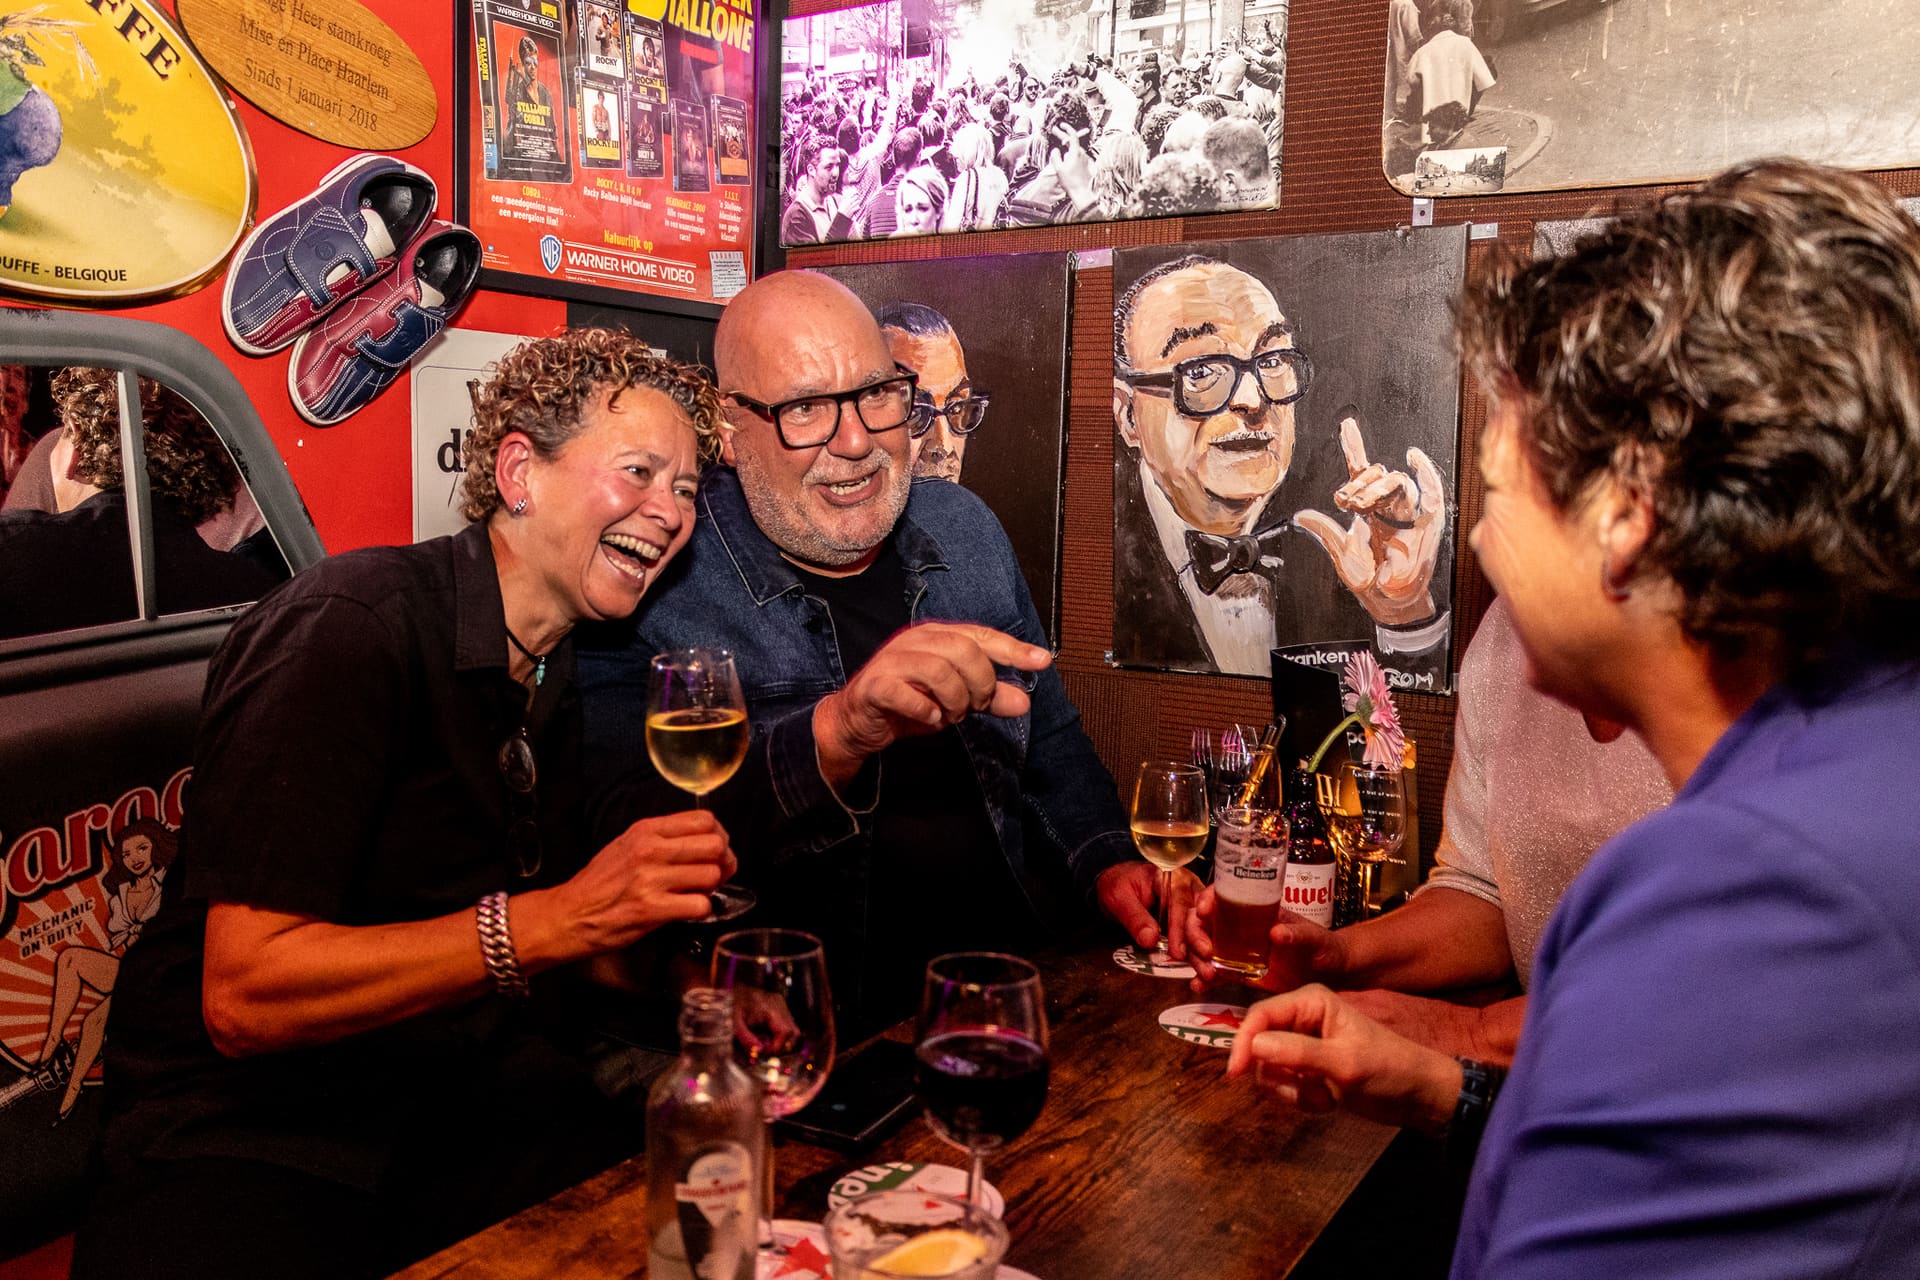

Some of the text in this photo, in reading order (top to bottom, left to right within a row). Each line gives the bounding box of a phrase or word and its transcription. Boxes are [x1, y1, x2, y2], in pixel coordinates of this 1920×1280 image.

[496, 5, 521, 19] WARNER
[519, 13, 538, 24] HOME
[538, 18, 554, 28] VIDEO
[291, 0, 324, 31] Heer
[326, 22, 393, 67] stamkroeg
[239, 14, 390, 100] Mise en Place Haarlem
[596, 55, 617, 66] ROCKY
[244, 57, 379, 132] Sinds 1 januari 2018
[587, 138, 611, 148] ROCKY
[499, 208, 512, 218] een
[603, 229, 654, 254] Natuurlijk op
[0, 256, 40, 275] UFFE
[54, 265, 128, 284] BELGIQUE
[566, 249, 620, 273] WARNER
[621, 260, 658, 279] HOME
[659, 265, 695, 285] VIDEO
[1236, 867, 1275, 879] Heineken
[1285, 878, 1332, 906] uvel
[20, 899, 96, 942] MECHANIC
[21, 919, 84, 957] ON DUTY
